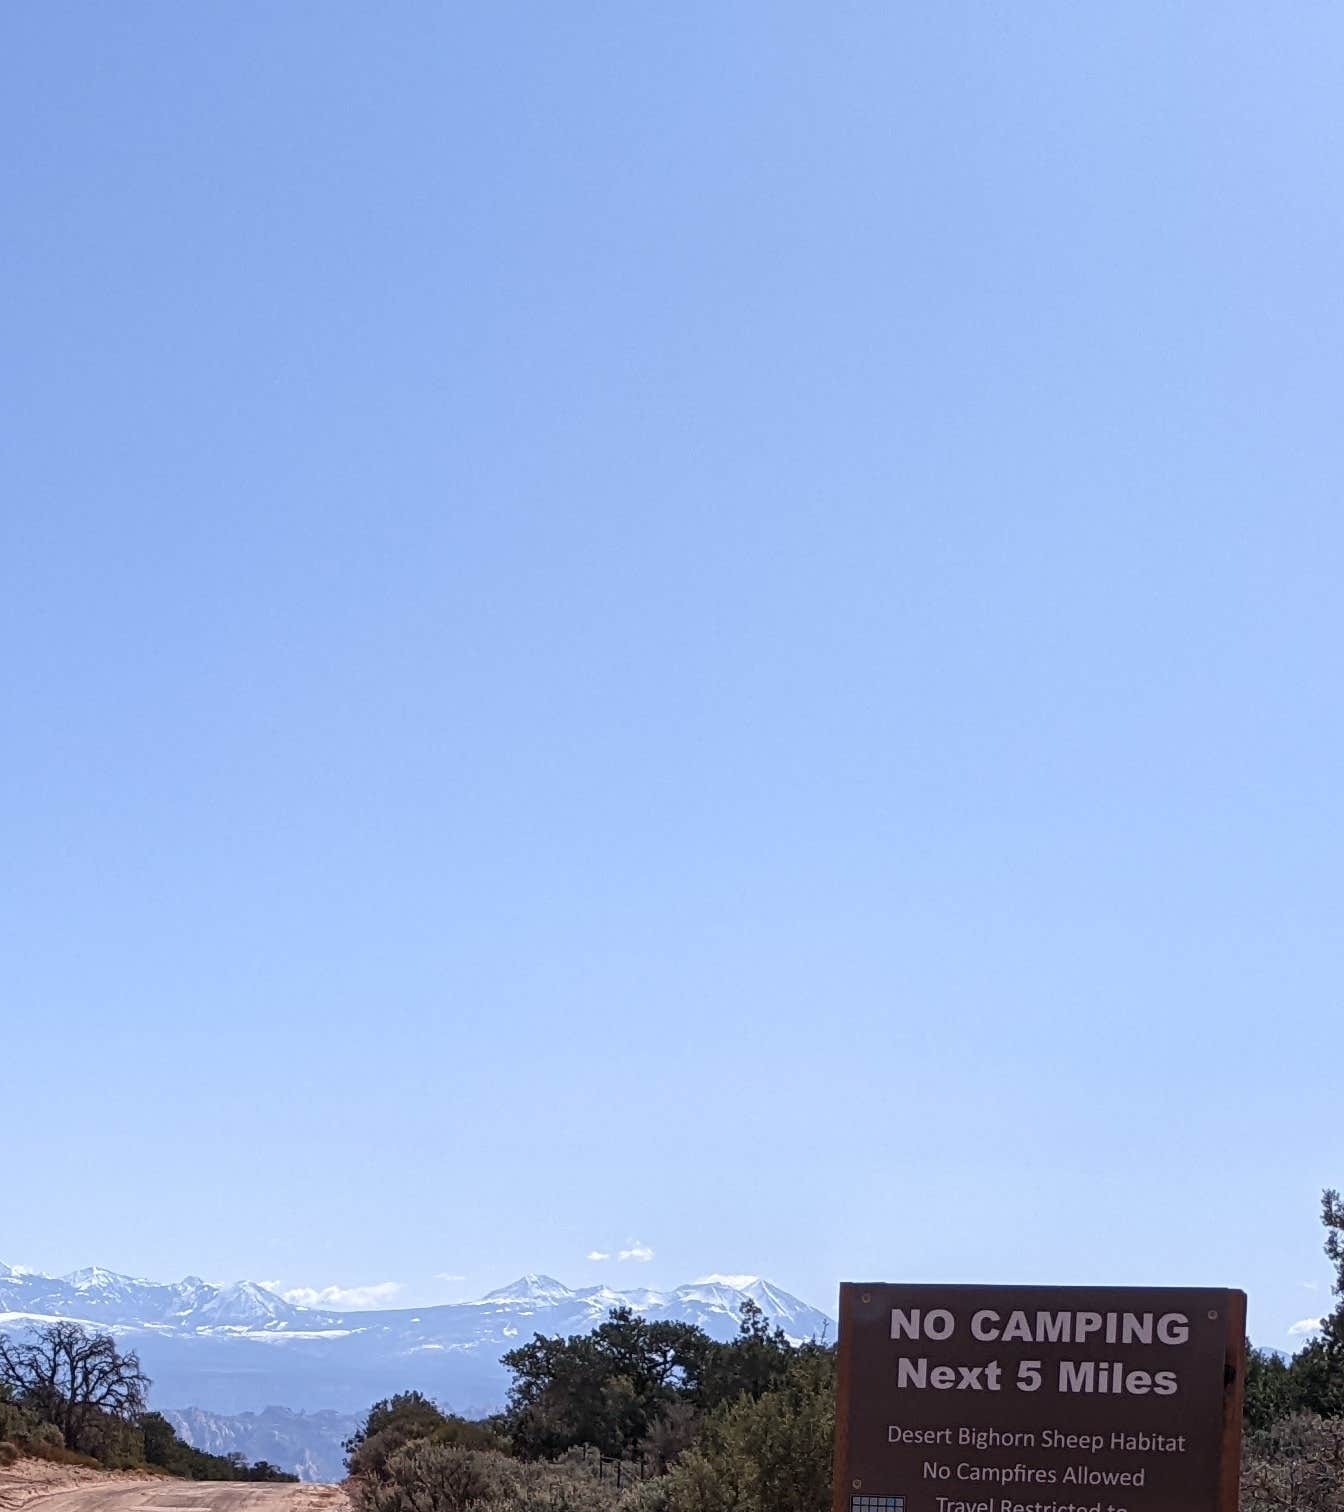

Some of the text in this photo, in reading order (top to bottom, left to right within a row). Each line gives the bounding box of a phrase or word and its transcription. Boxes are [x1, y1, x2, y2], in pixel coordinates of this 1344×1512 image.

[891, 1309, 1188, 1344] NO CAMPING
[898, 1358, 1177, 1395] Next 5 Miles
[888, 1426, 1185, 1453] Desert Bighorn Sheep Habitat
[924, 1462, 1144, 1486] No Campfires Allowed
